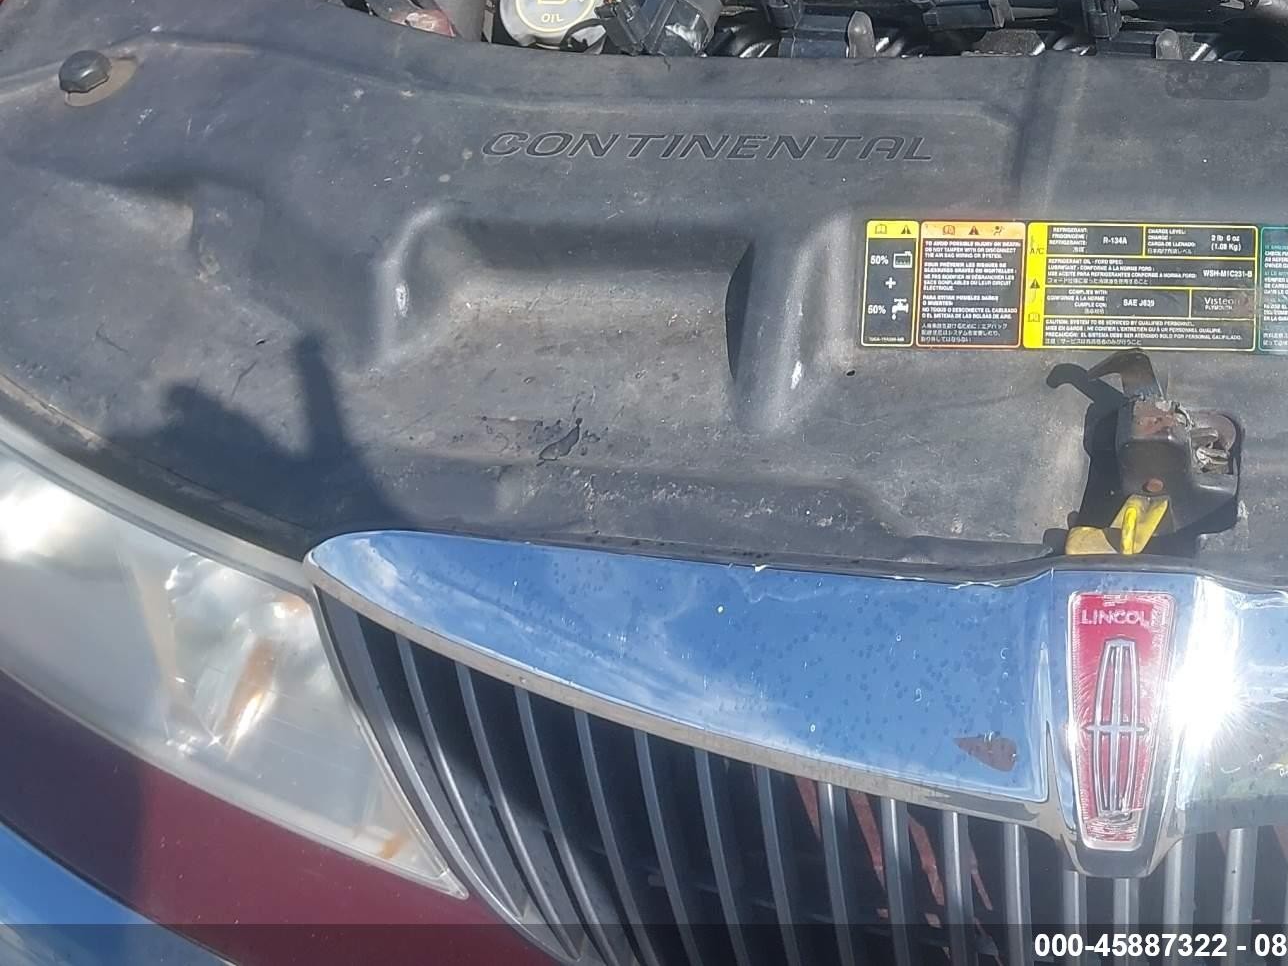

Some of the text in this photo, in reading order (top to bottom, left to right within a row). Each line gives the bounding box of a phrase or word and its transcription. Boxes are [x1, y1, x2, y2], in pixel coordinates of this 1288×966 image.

[542, 13, 564, 23] OIL
[481, 132, 933, 161] CONTINENTAL
[1103, 236, 1128, 245] R-134A
[1123, 298, 1138, 307] SAE
